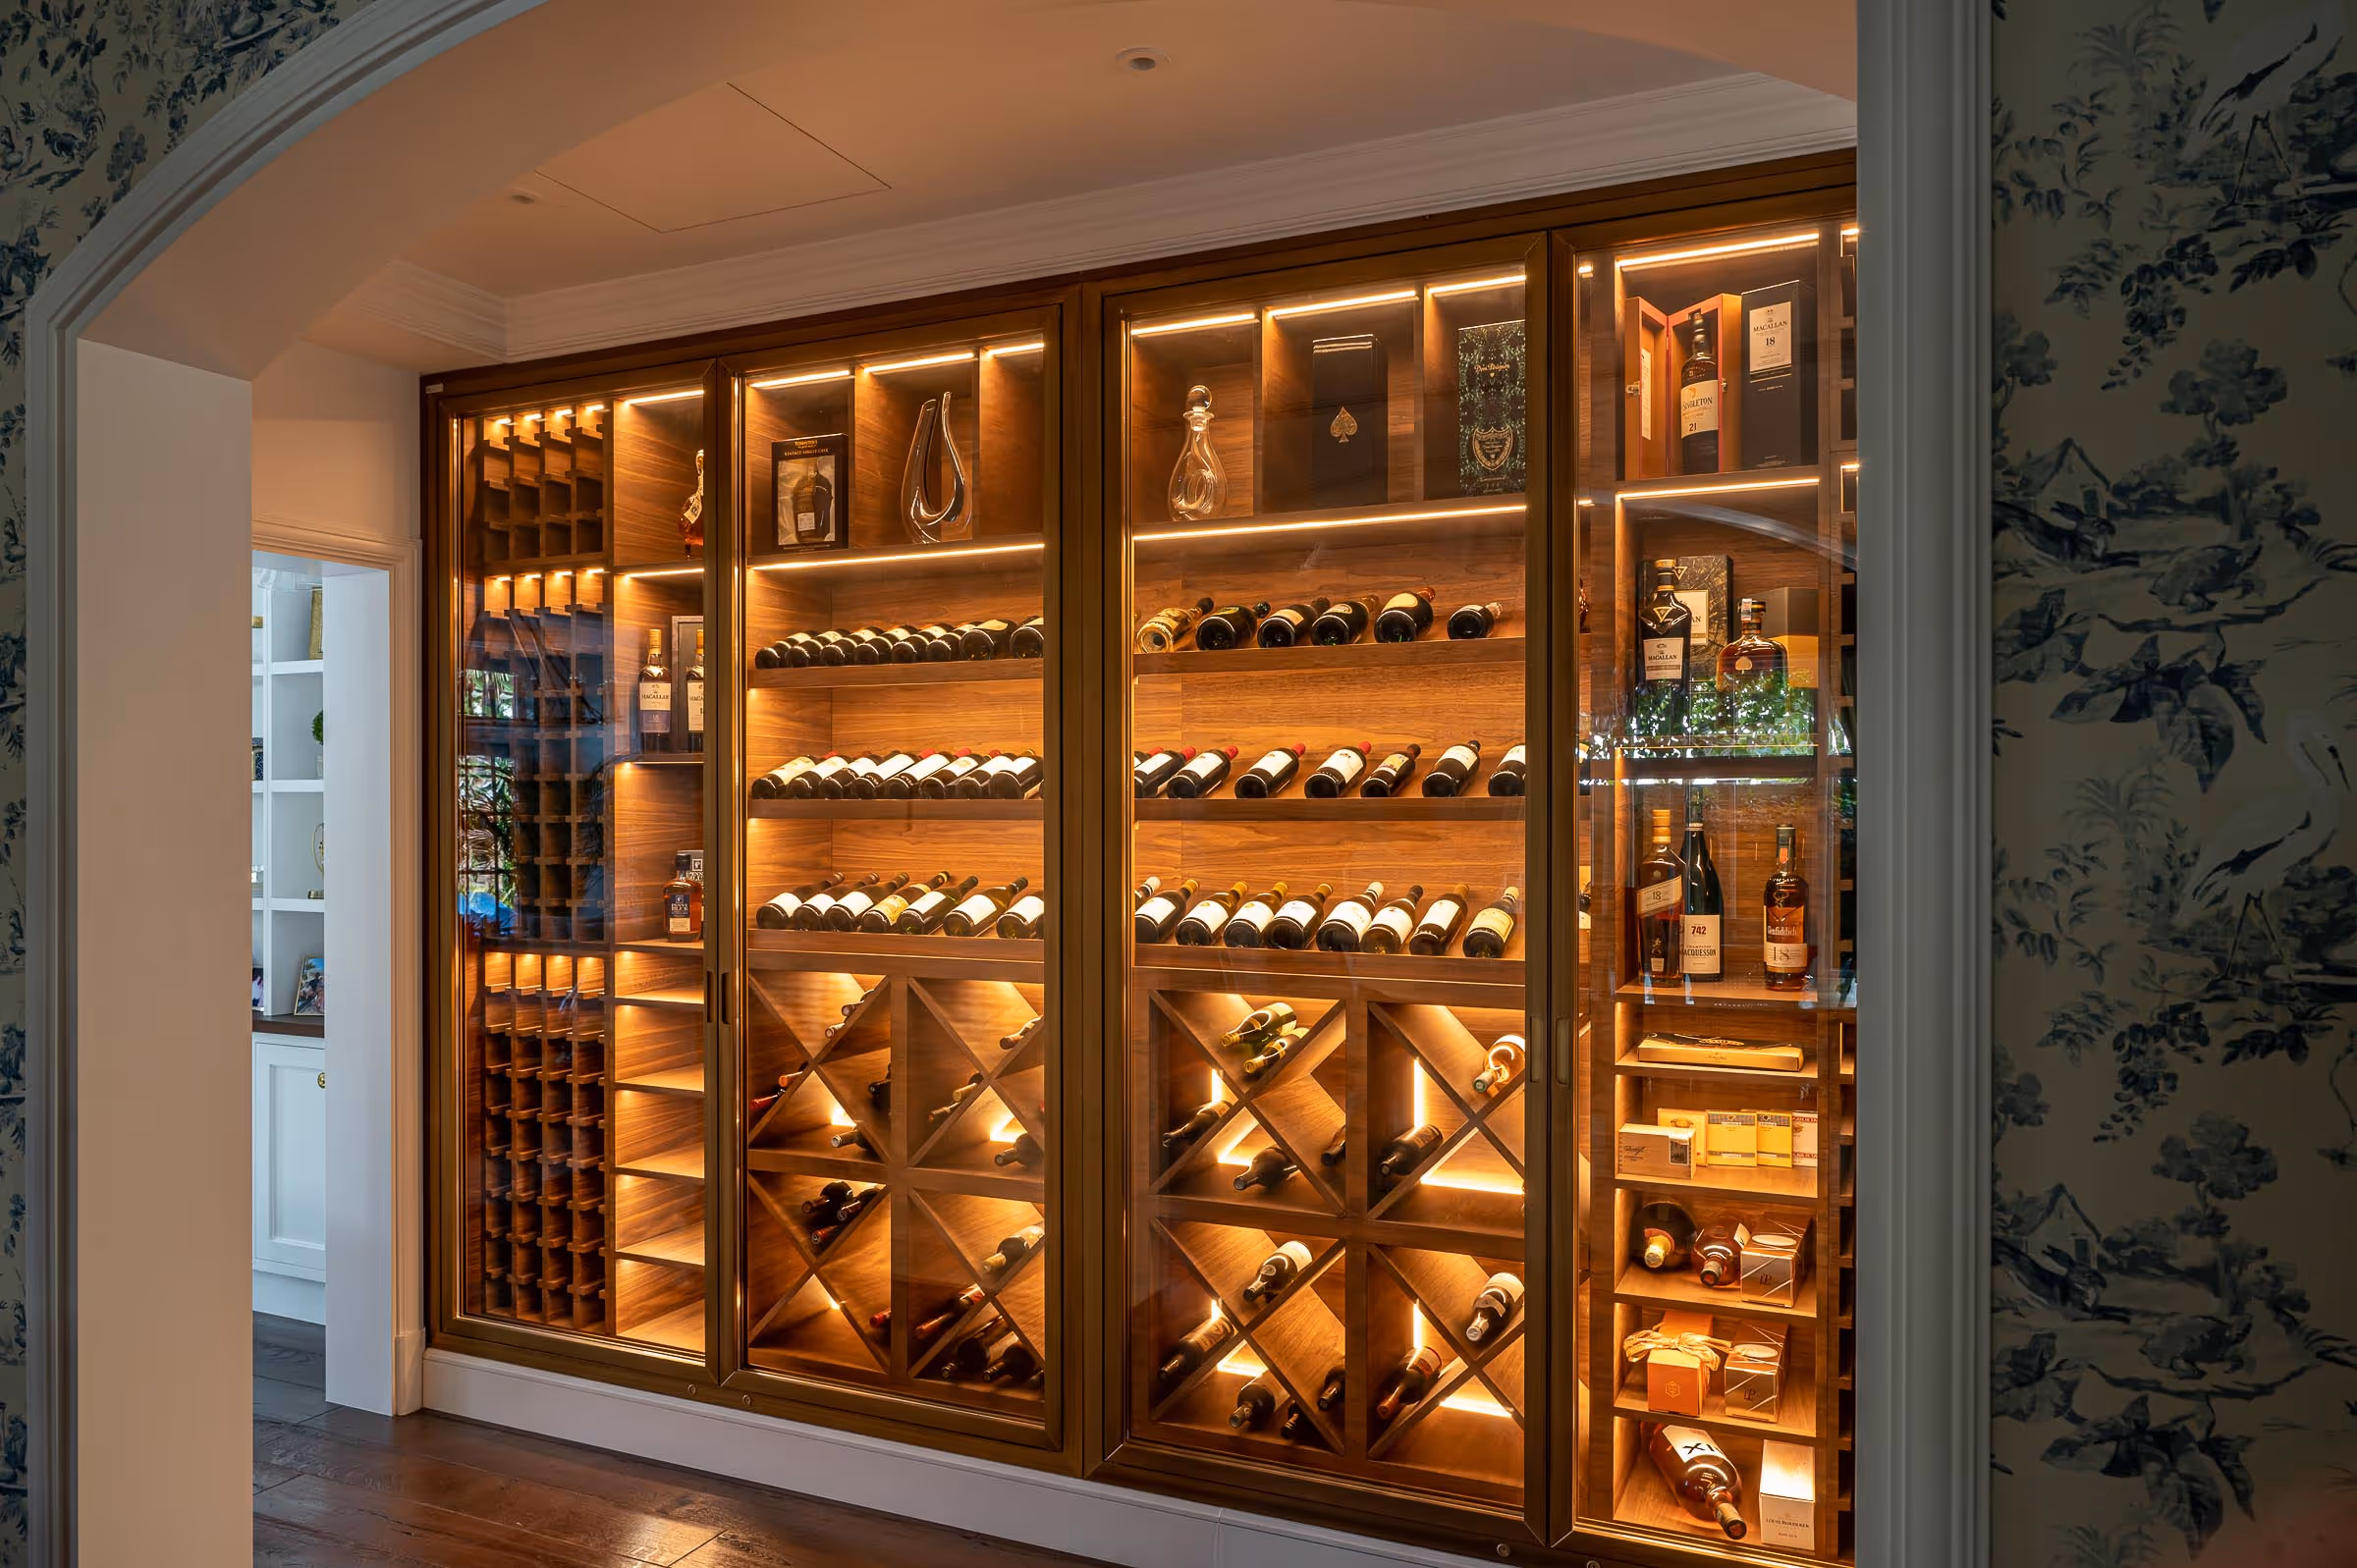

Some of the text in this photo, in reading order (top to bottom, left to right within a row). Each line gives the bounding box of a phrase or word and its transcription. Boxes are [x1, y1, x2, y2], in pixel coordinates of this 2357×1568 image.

[1753, 320, 1787, 332] MACALLAN
[1766, 337, 1776, 347] 18
[1682, 397, 1713, 410] SINGLETON
[1688, 422, 1697, 432] 21
[1653, 891, 1662, 900] 18
[1691, 926, 1707, 935] 742
[1768, 925, 1797, 936] Glenfiddich
[1773, 946, 1789, 961] 18
